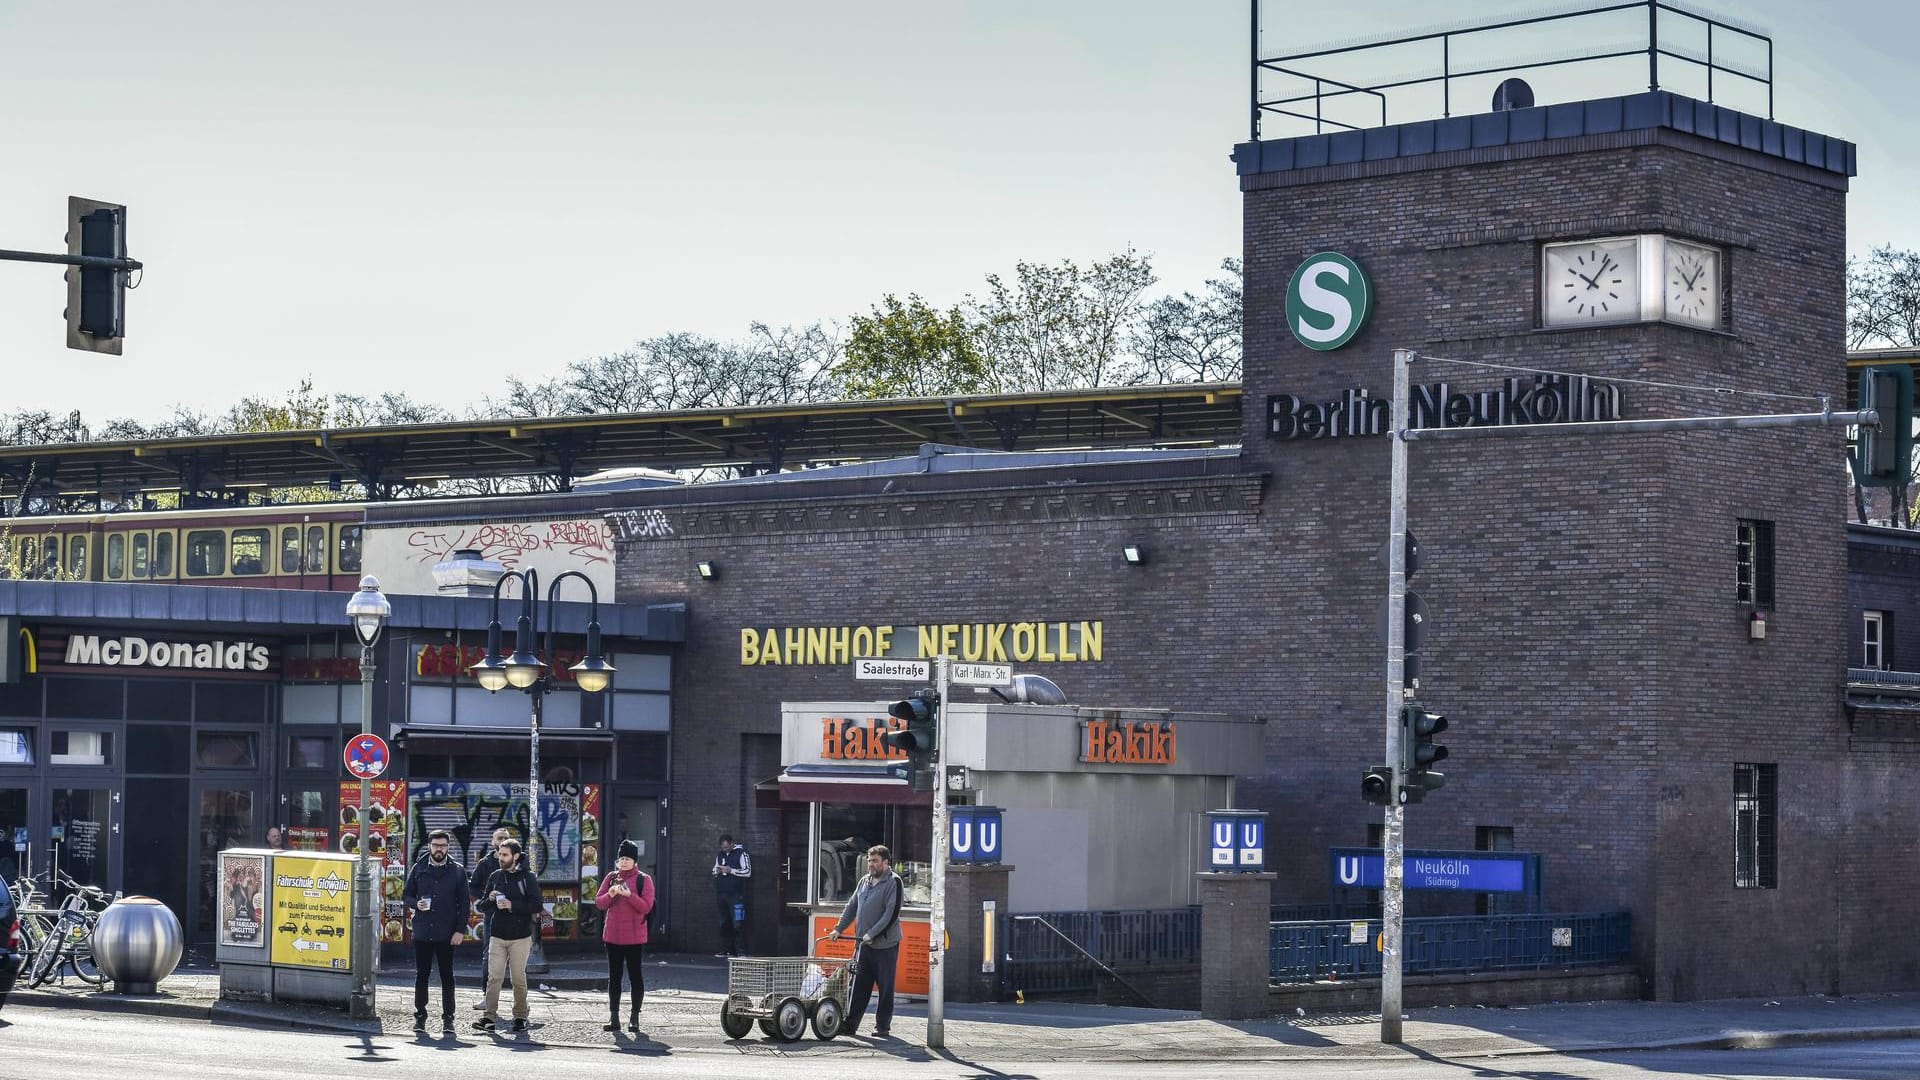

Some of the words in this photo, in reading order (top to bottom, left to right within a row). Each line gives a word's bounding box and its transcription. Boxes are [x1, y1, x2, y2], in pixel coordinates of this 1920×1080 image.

[1299, 261, 1352, 342] S
[1267, 390, 1394, 440] Berlin
[1408, 374, 1622, 430] Neukölln
[65, 634, 270, 671] McDonald's
[741, 625, 894, 666] BAHNHOF
[917, 620, 1103, 663] NEUKÖLLN
[863, 662, 924, 677] Saalestraße
[821, 717, 909, 760] Haki
[1086, 720, 1176, 765] Hakiki
[953, 823, 972, 853] U
[980, 823, 997, 853] U
[1216, 823, 1232, 848] U
[1245, 824, 1257, 848] U
[276, 875, 314, 889] Fahrschule
[316, 877, 349, 891] Glowalla
[1340, 857, 1358, 884] U
[1415, 859, 1470, 876] Neukölln
[1425, 876, 1460, 888] (Südring)
[279, 901, 287, 909] Mit
[288, 902, 308, 911] Qualität
[320, 904, 345, 913] Sicherheit
[301, 912, 334, 921] Führerschein
